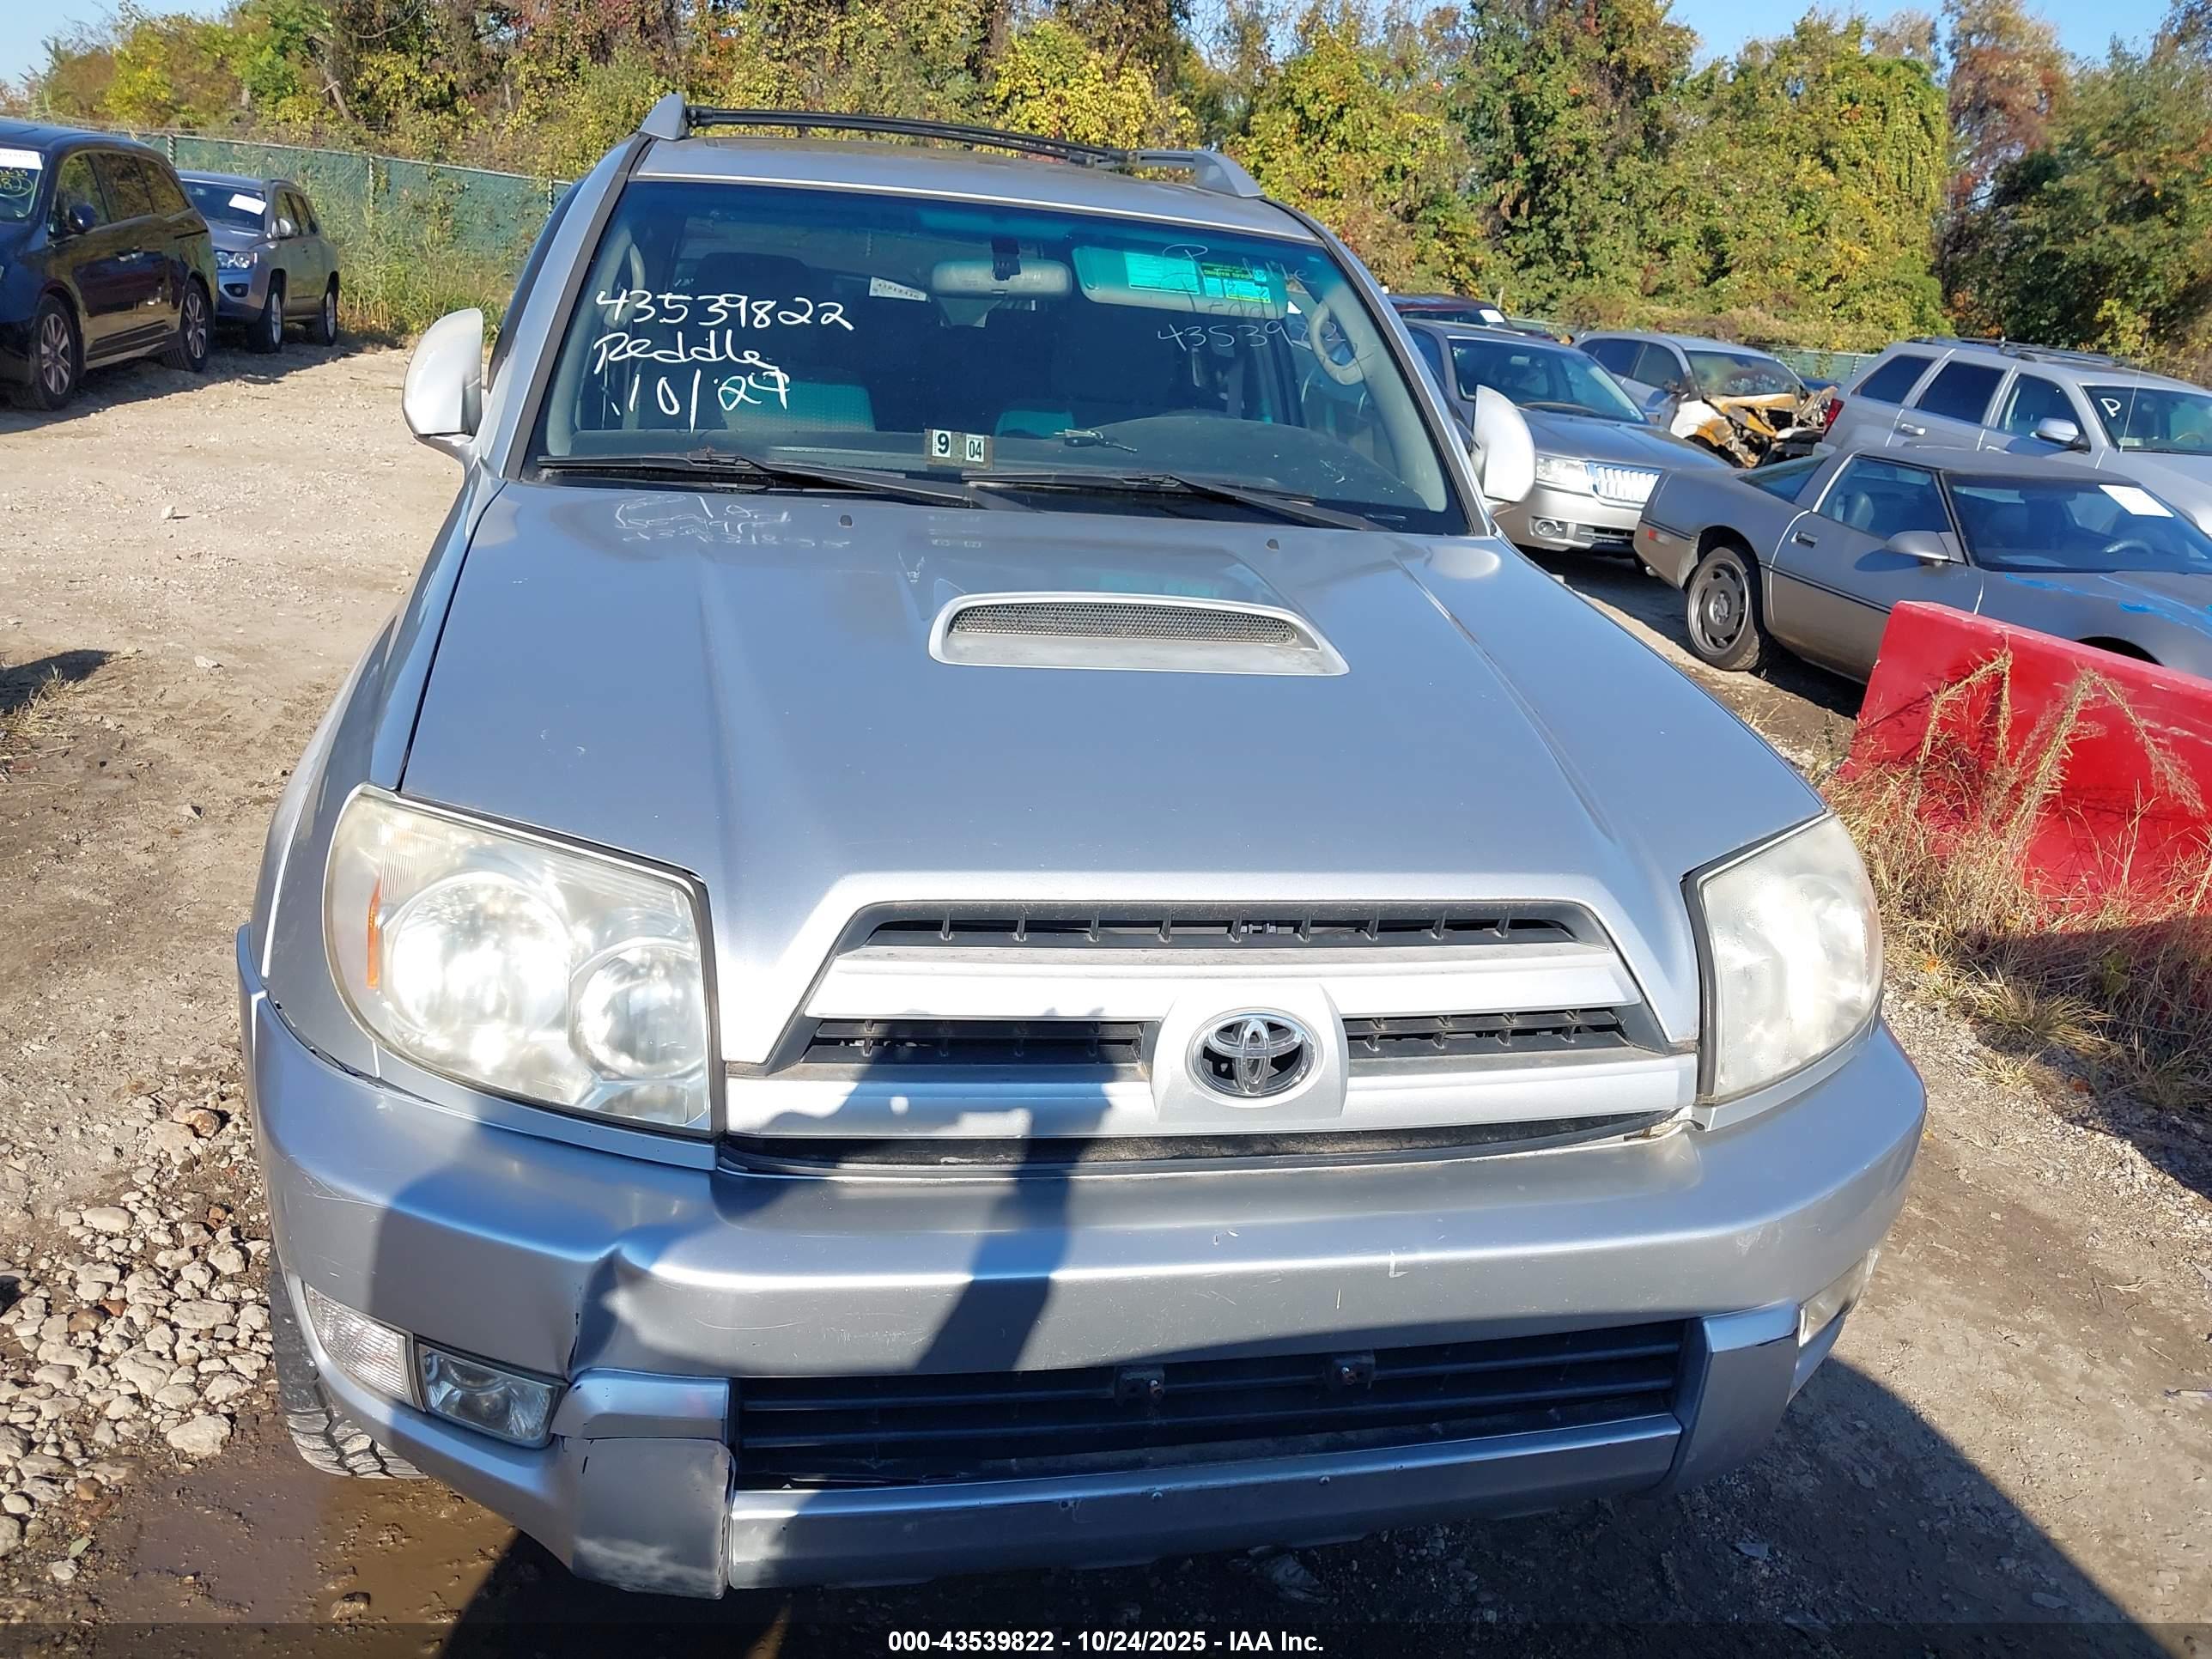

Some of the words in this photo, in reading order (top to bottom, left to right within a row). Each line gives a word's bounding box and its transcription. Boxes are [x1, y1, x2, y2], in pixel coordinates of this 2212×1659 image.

[595, 289, 855, 331] 43539822
[593, 329, 780, 375] Peddle
[2100, 398, 2122, 418] P
[937, 433, 950, 454] 9
[969, 441, 982, 459] 04
